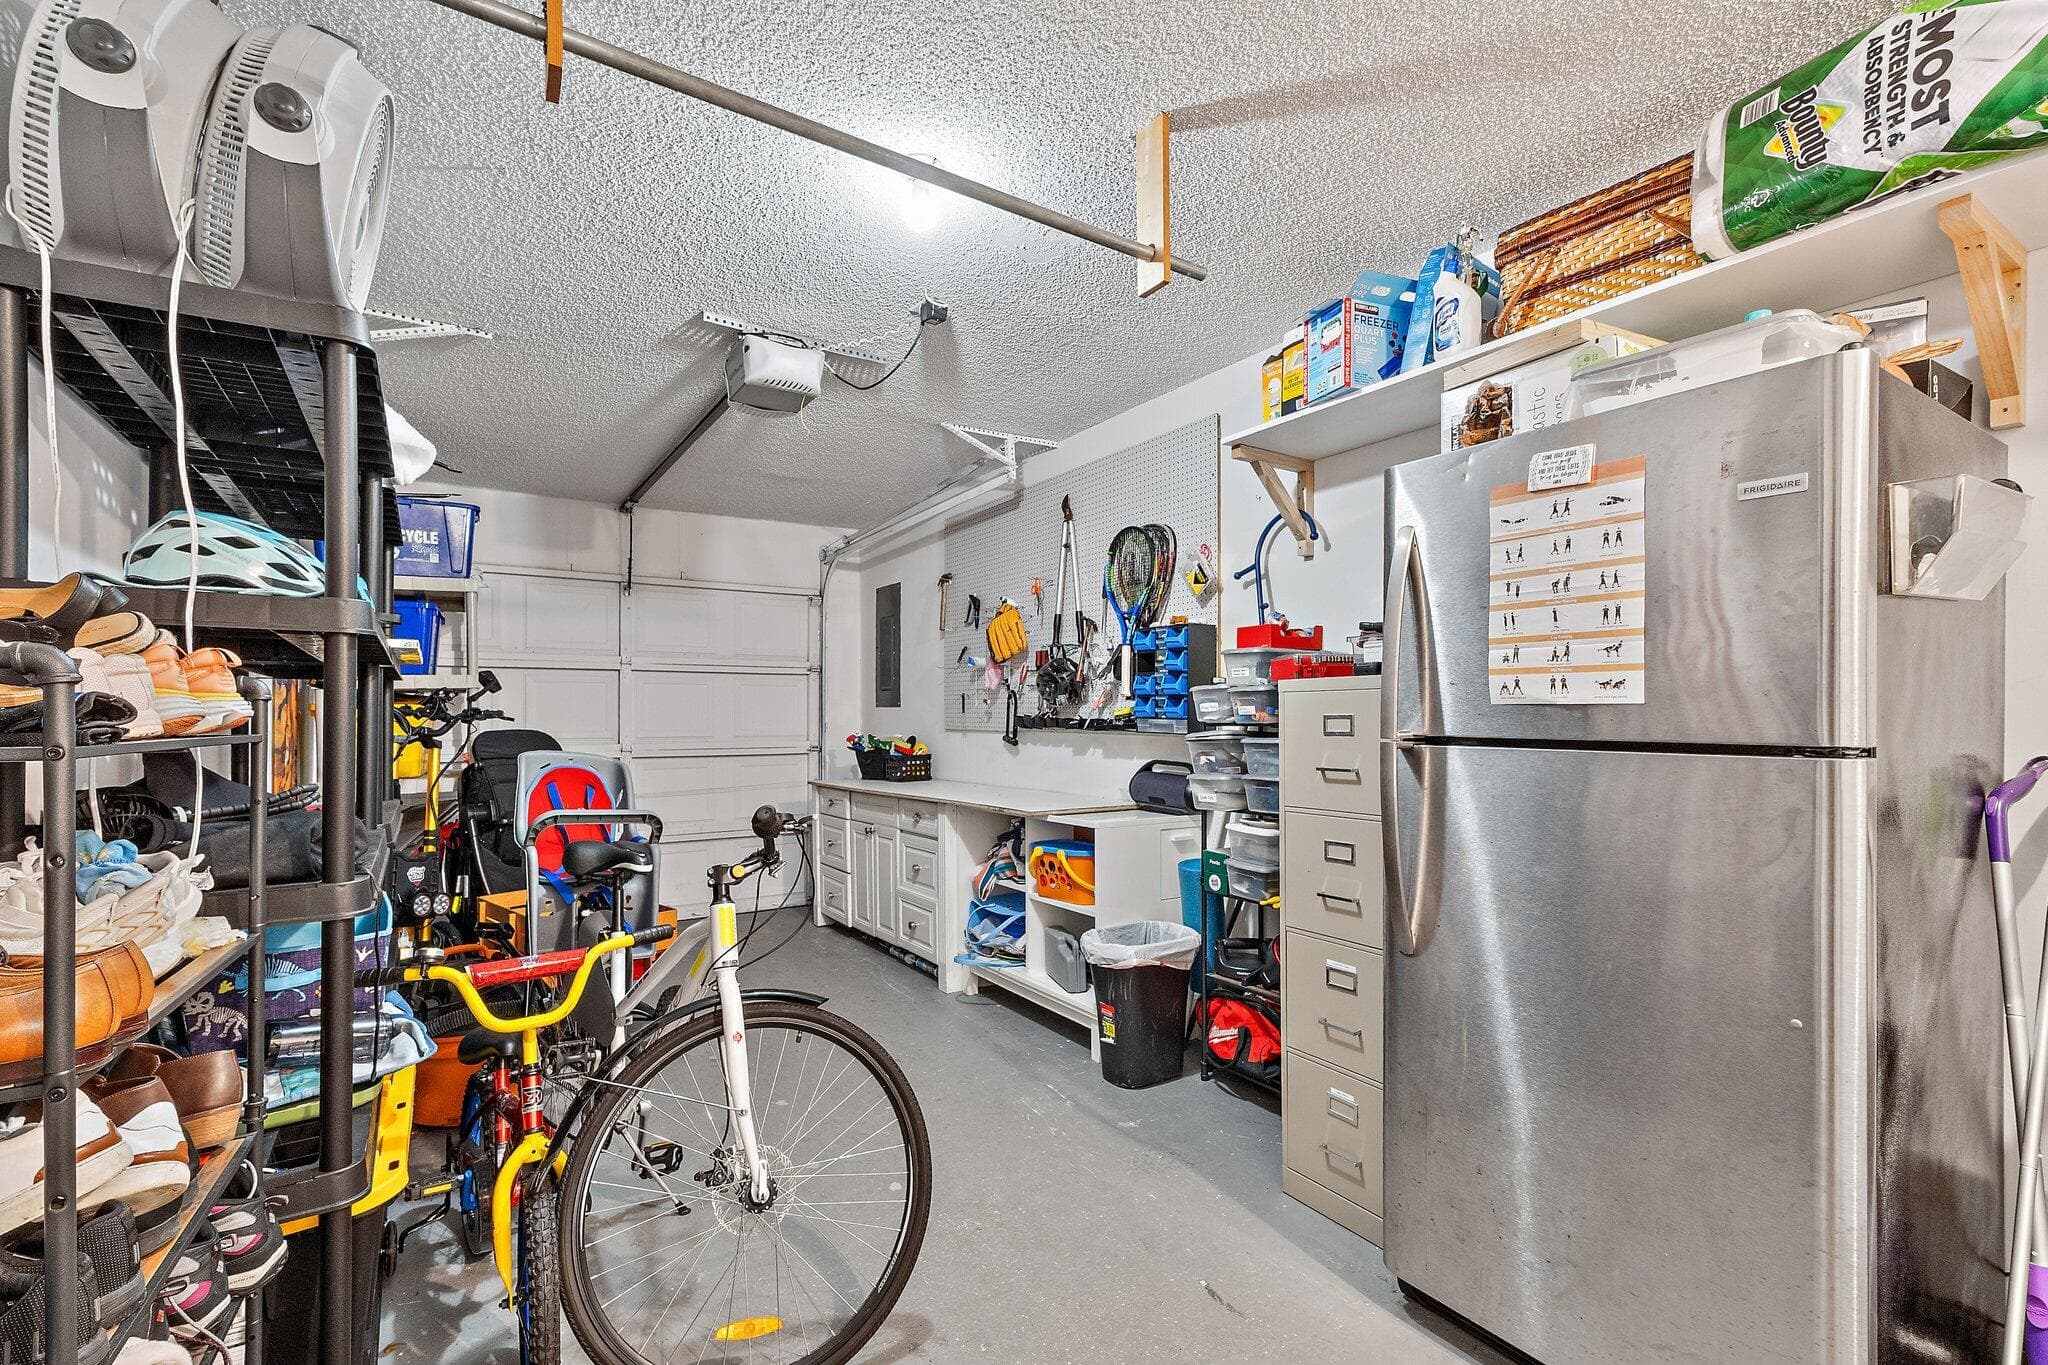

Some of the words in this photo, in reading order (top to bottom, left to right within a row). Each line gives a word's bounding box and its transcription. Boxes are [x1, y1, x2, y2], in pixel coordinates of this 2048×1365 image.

[1886, 19, 1912, 130] STRENGTH
[1911, 10, 1956, 130] MOST
[1862, 34, 1885, 155] ABSORBENCY
[1774, 120, 1797, 163] Advanced
[1780, 86, 1829, 169] Bounty
[1887, 132, 1905, 148] &
[1354, 314, 1399, 331] FREEZER
[1354, 325, 1385, 338] QUART
[1354, 335, 1377, 345] PLUS
[1527, 387, 1546, 430] astic
[1743, 479, 1801, 494] FRIGIDAIRE
[198, 537, 252, 565] SCHWINN
[401, 529, 439, 545] CYCLE
